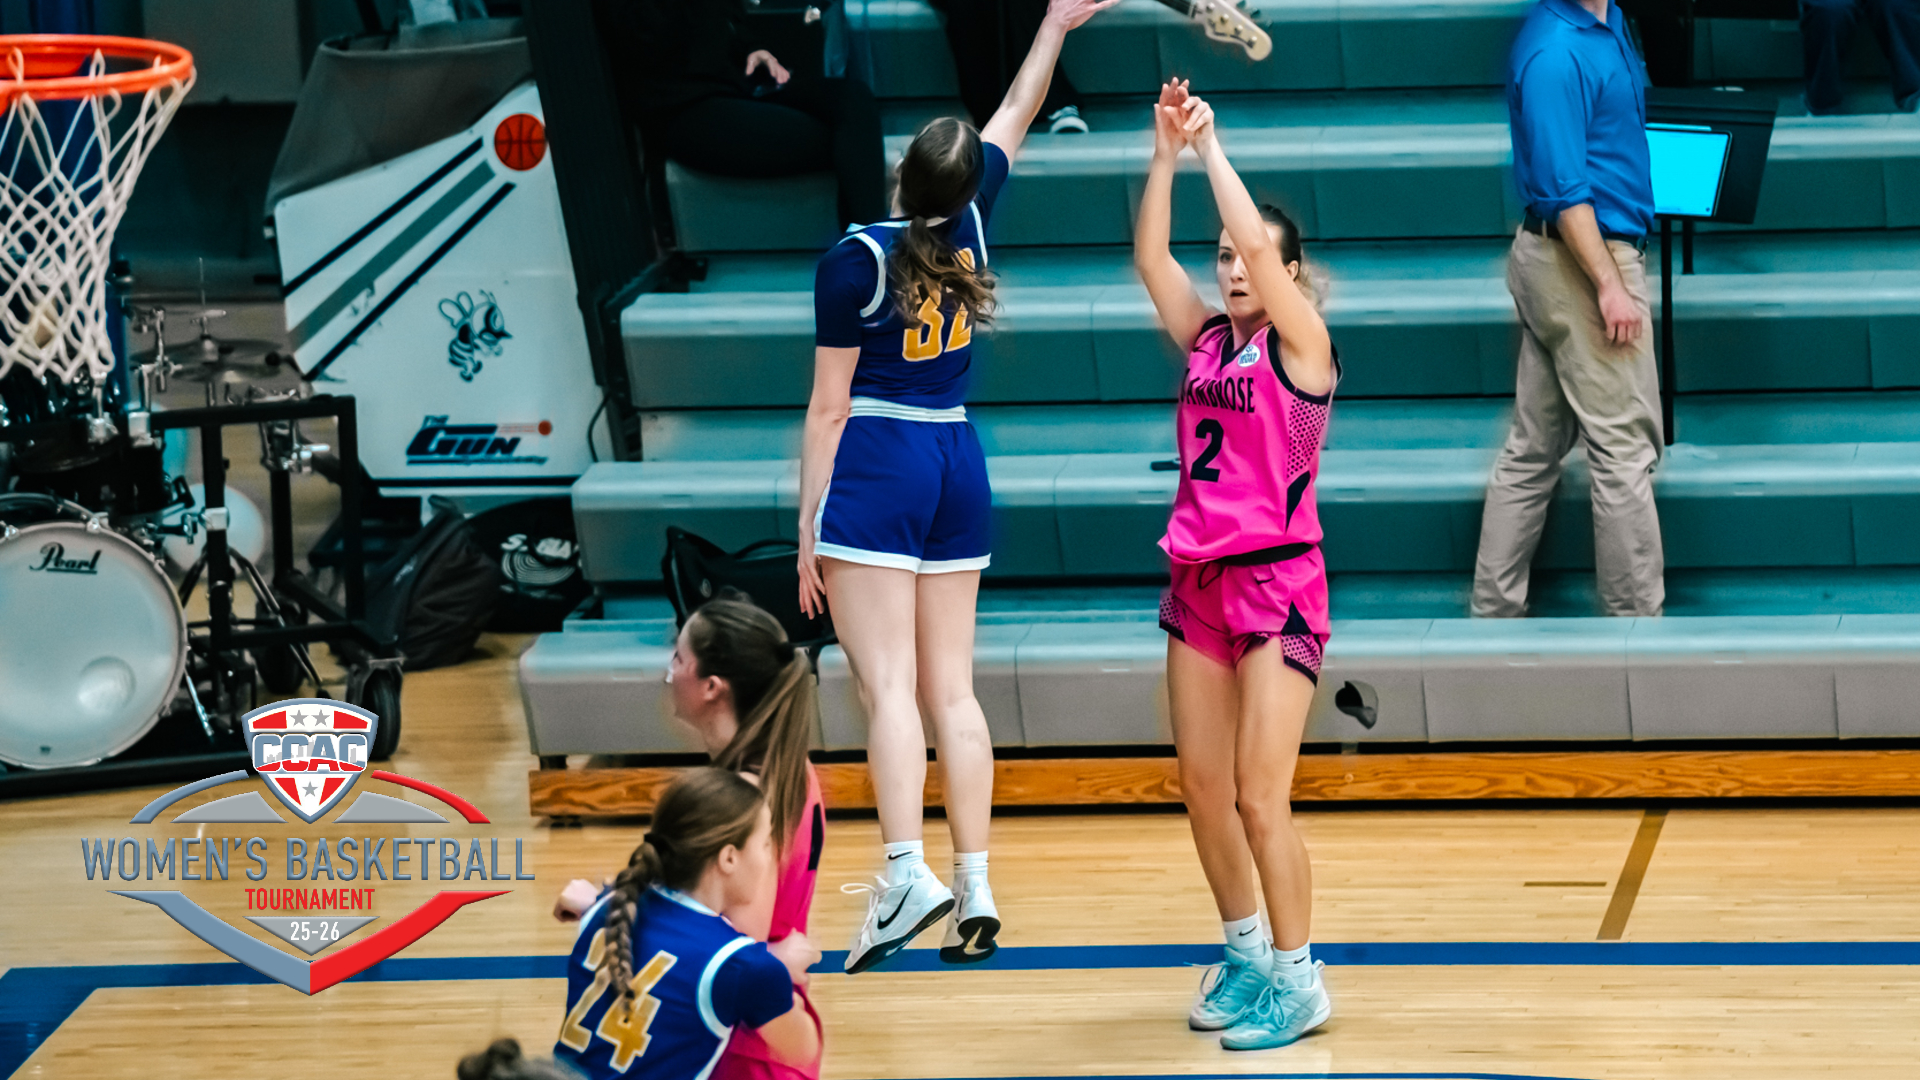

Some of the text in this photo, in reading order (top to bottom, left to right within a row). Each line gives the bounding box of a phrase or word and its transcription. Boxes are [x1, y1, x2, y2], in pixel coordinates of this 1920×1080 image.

[1190, 418, 1224, 483] 2
[29, 542, 101, 572] Pearl
[560, 927, 679, 1074] 24
